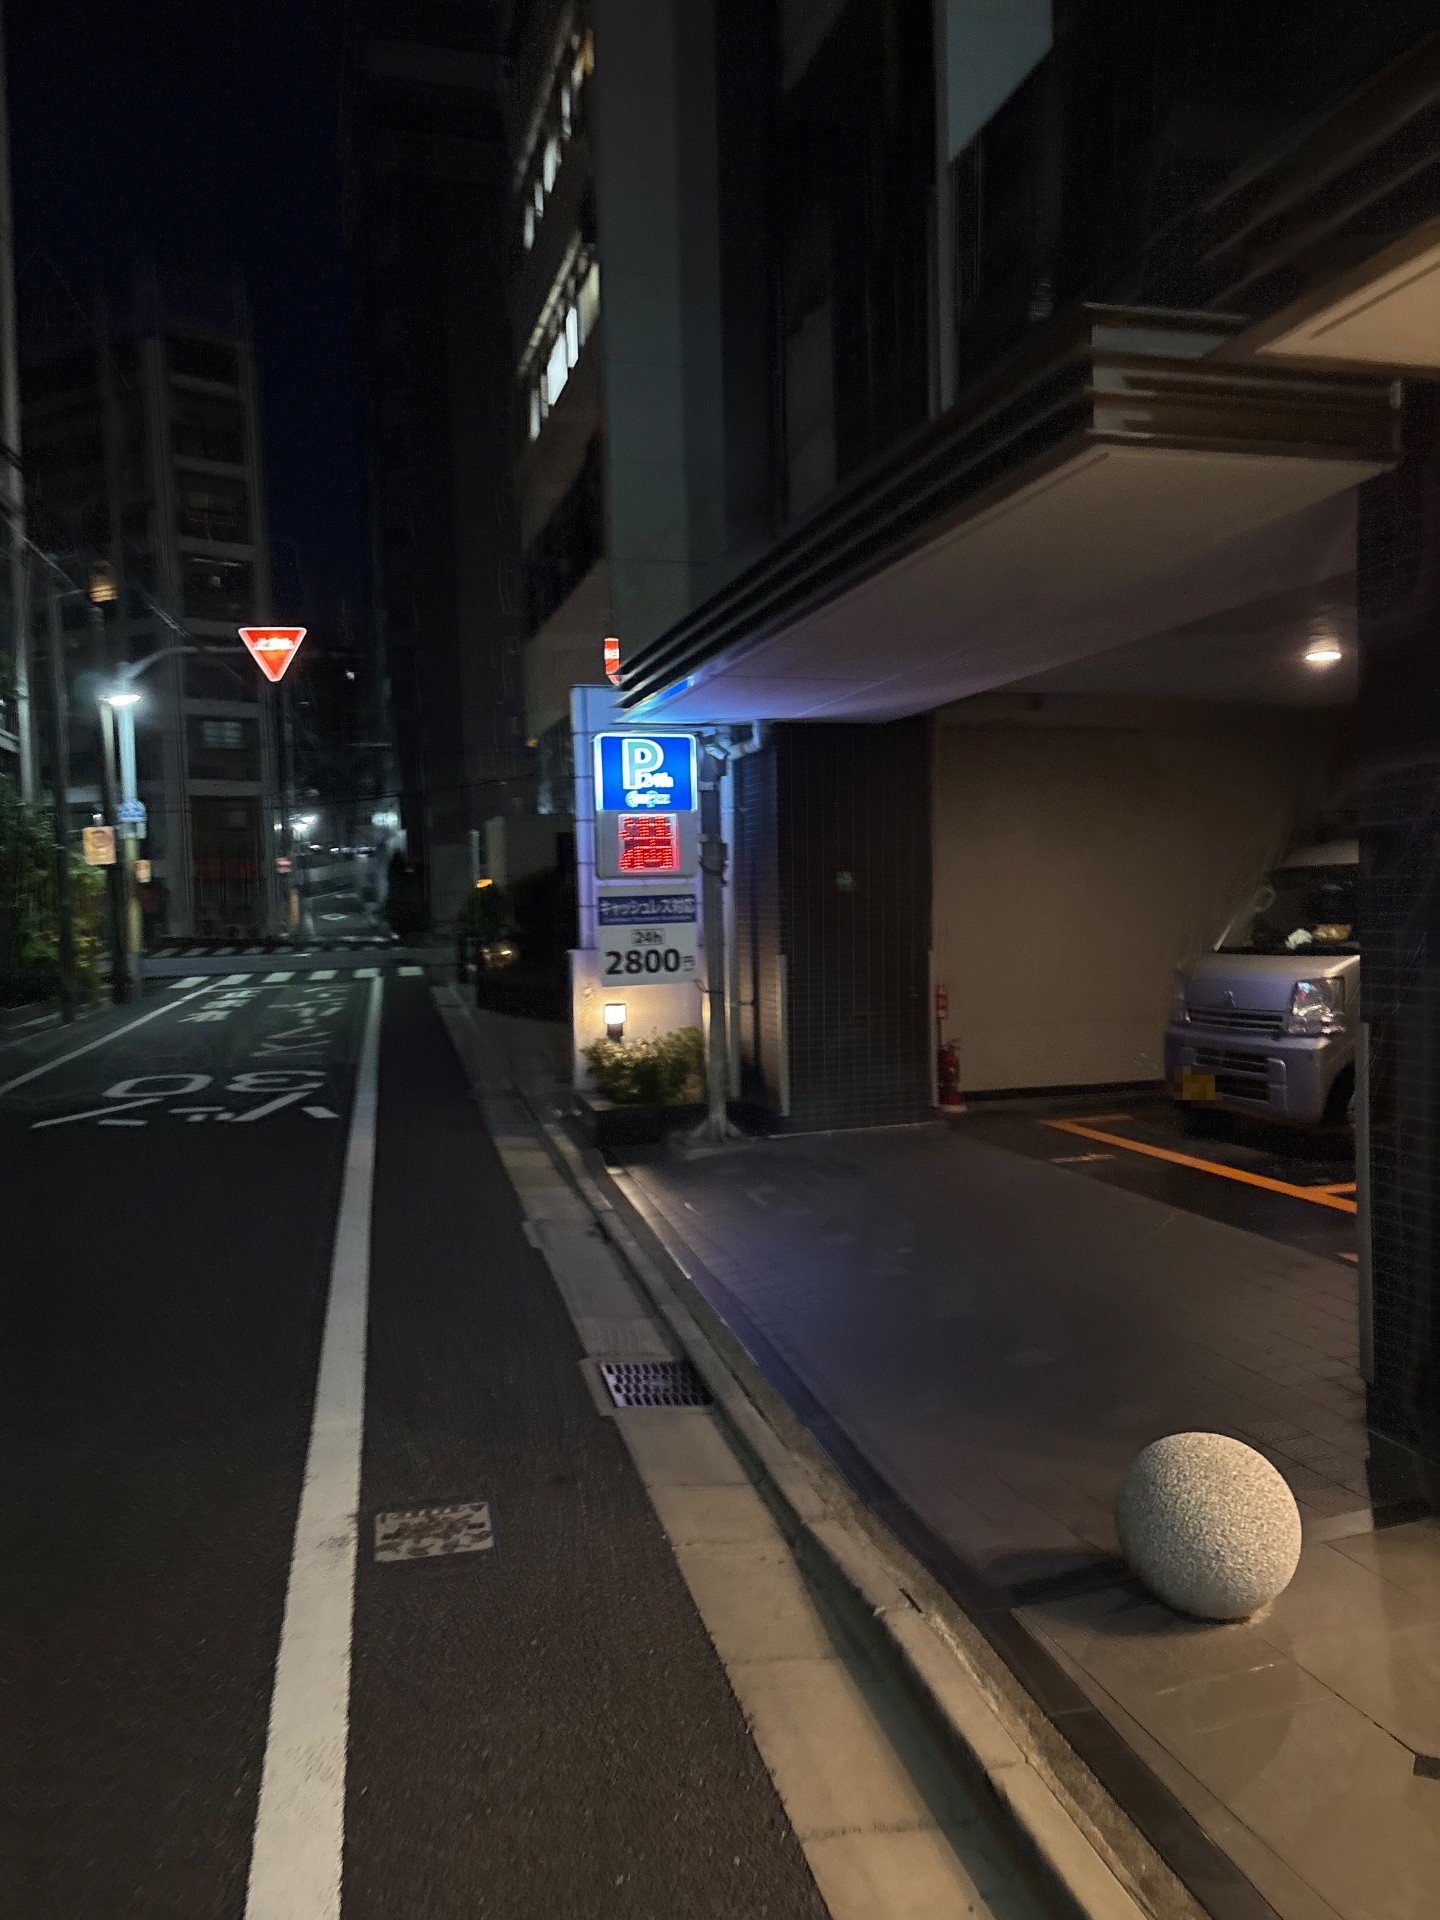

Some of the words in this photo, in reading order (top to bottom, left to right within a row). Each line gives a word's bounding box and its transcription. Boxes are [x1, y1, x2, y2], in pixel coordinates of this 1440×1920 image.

[622, 739, 664, 789] P
[618, 816, 674, 869] 満
[101, 1070, 328, 1098] 30
